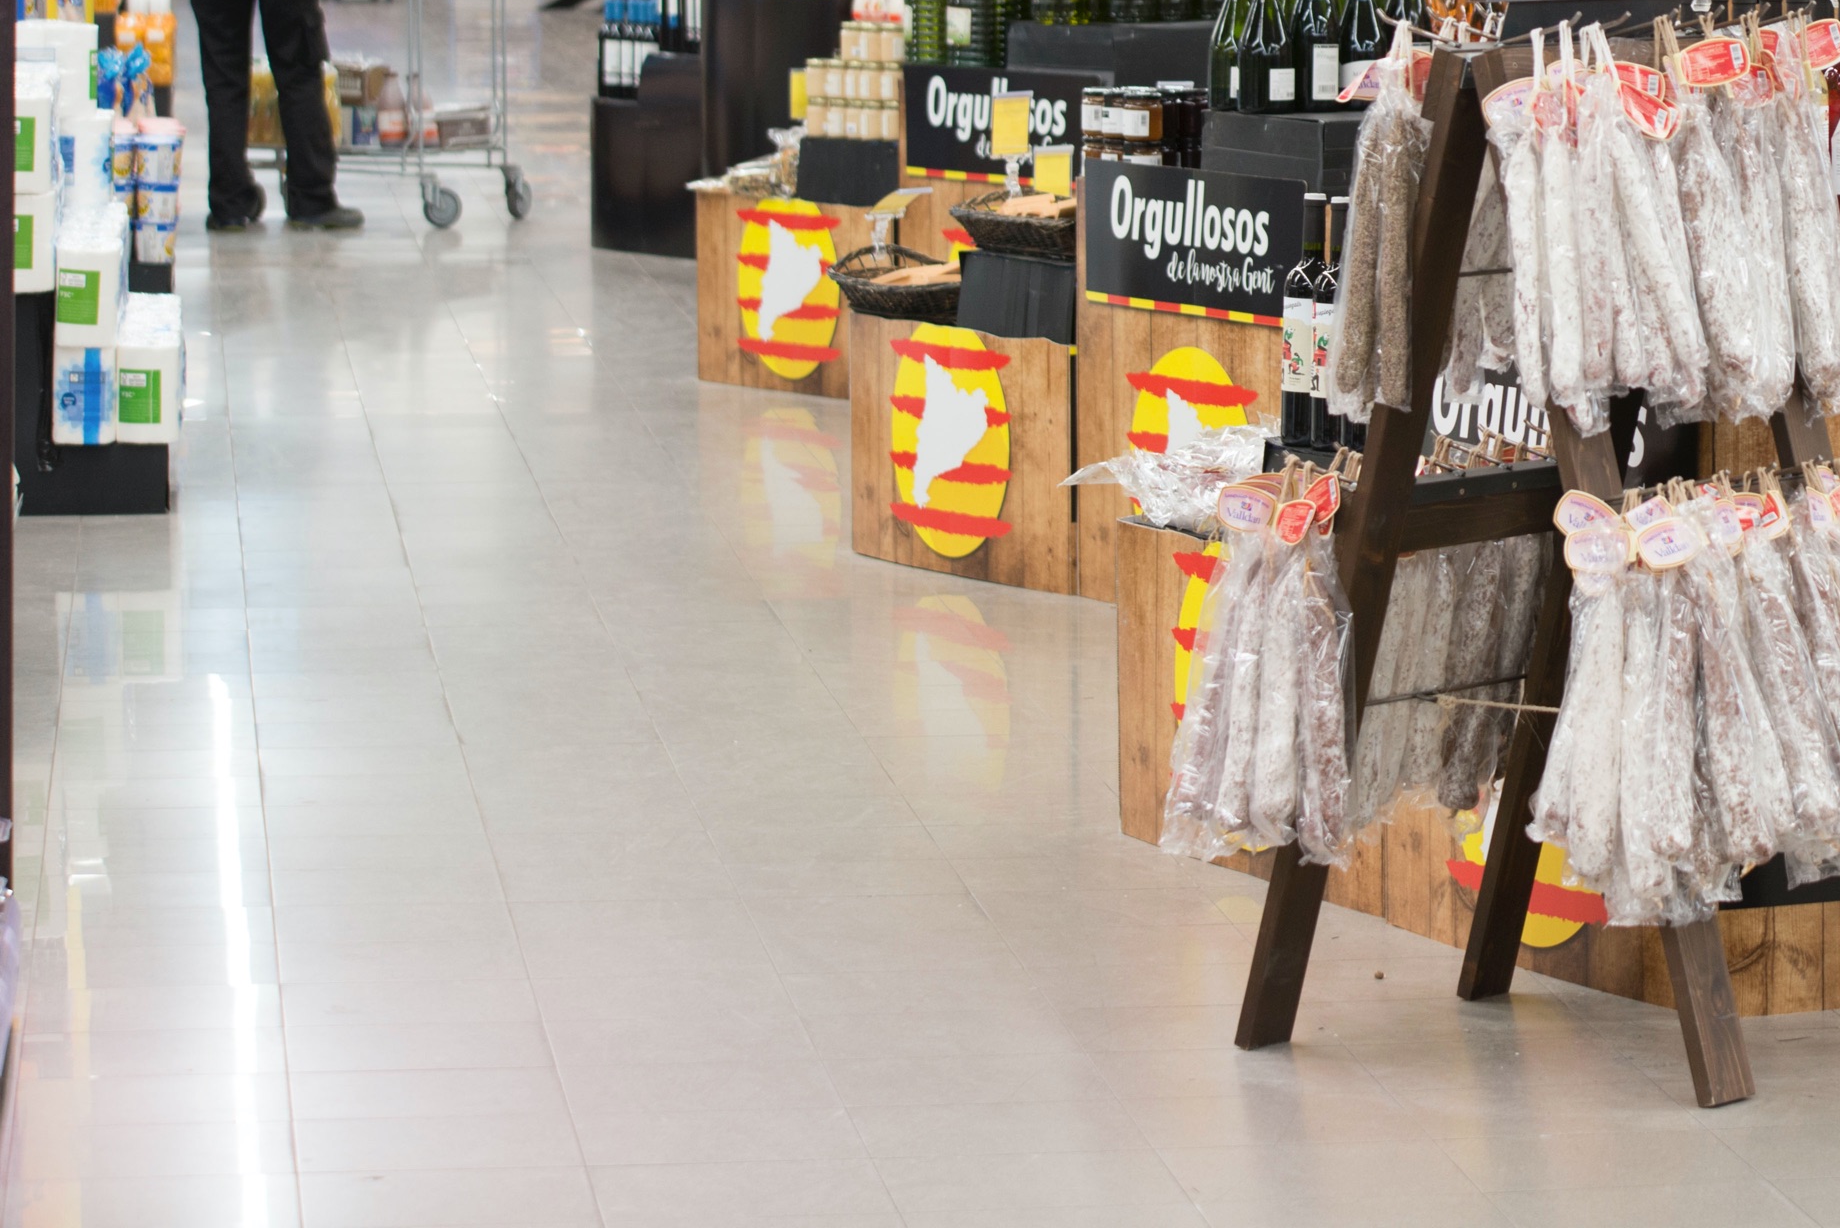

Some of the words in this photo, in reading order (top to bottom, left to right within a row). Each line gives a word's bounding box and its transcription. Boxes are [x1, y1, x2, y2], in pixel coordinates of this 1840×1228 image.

[1111, 174, 1270, 260] Orgullosos
[1167, 251, 1186, 283] de
[1186, 248, 1201, 284] la
[1201, 259, 1242, 293] nostra
[1241, 256, 1276, 295] Gent
